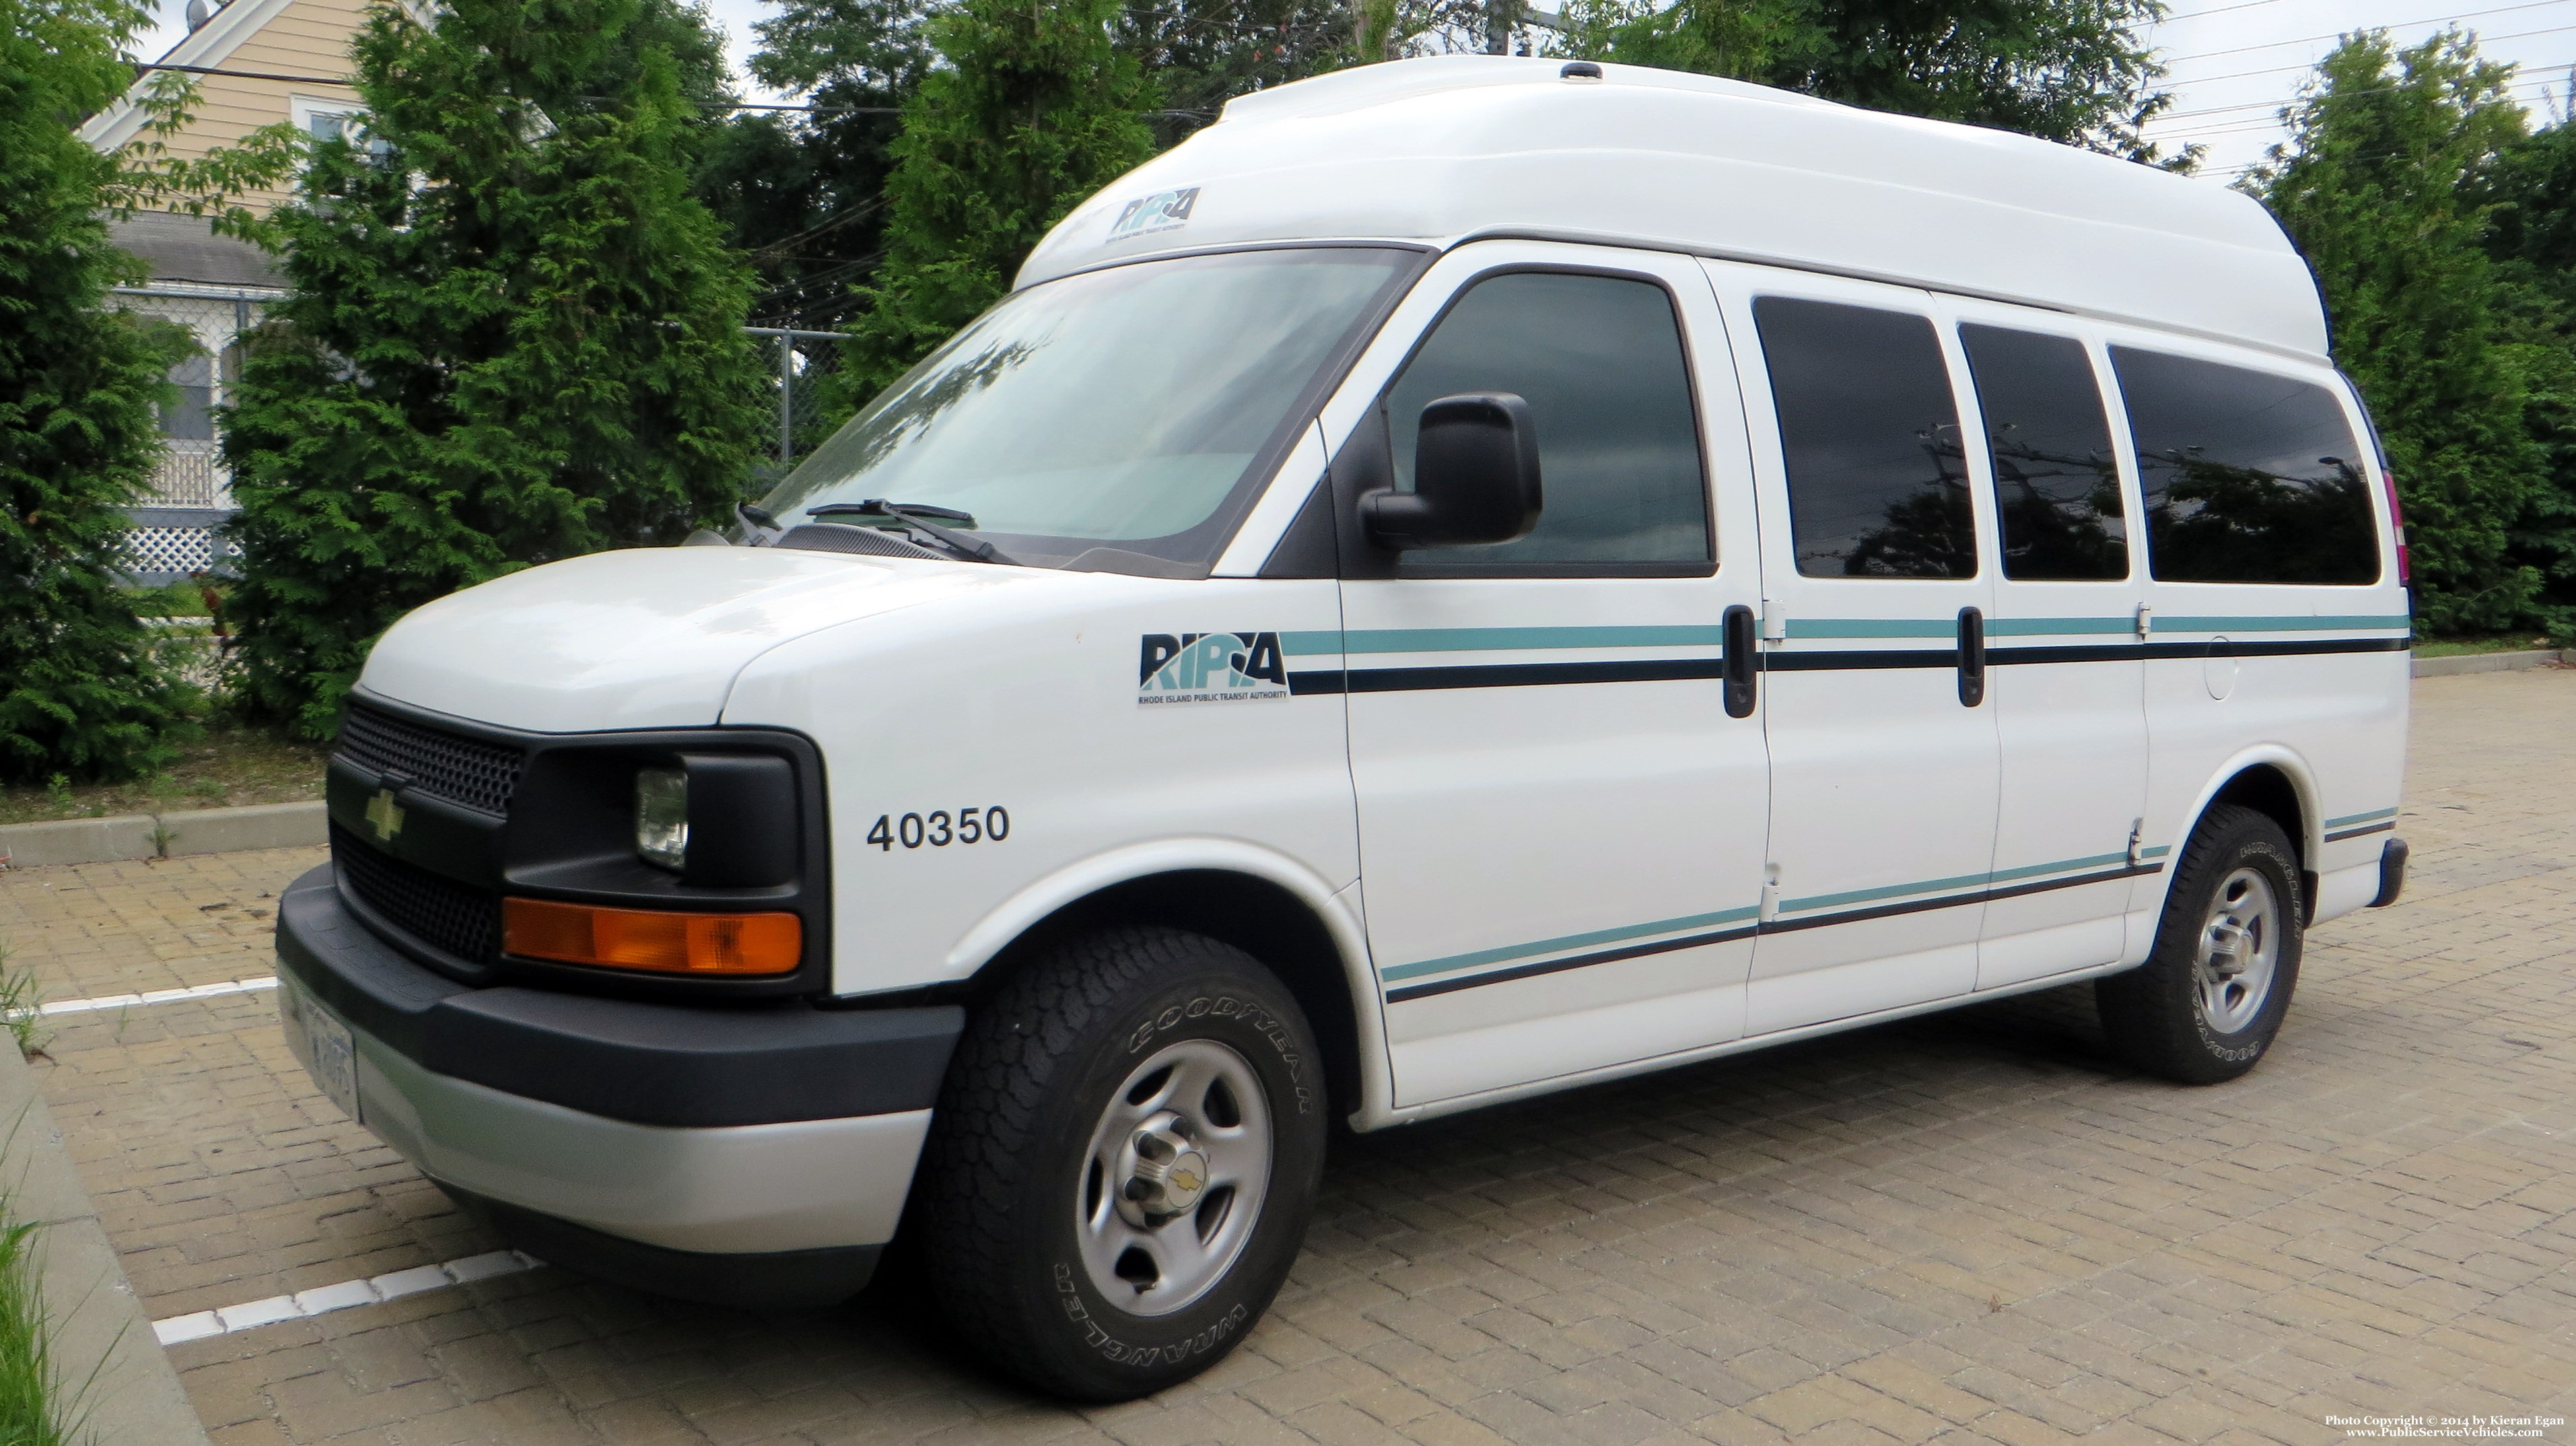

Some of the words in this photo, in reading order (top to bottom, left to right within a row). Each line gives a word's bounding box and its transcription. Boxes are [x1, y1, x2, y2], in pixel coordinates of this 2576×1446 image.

[1139, 695, 1164, 704] RHODE
[1166, 694, 1192, 703] ISLAND
[1193, 693, 1219, 701] PUBLIC
[1220, 691, 1249, 701] TRANSIT
[1250, 690, 1287, 700] AUTHORITY
[866, 805, 1010, 852] 40350
[1128, 996, 1312, 1114] GOODYEAR
[1054, 1262, 1249, 1367] WRANGLER
